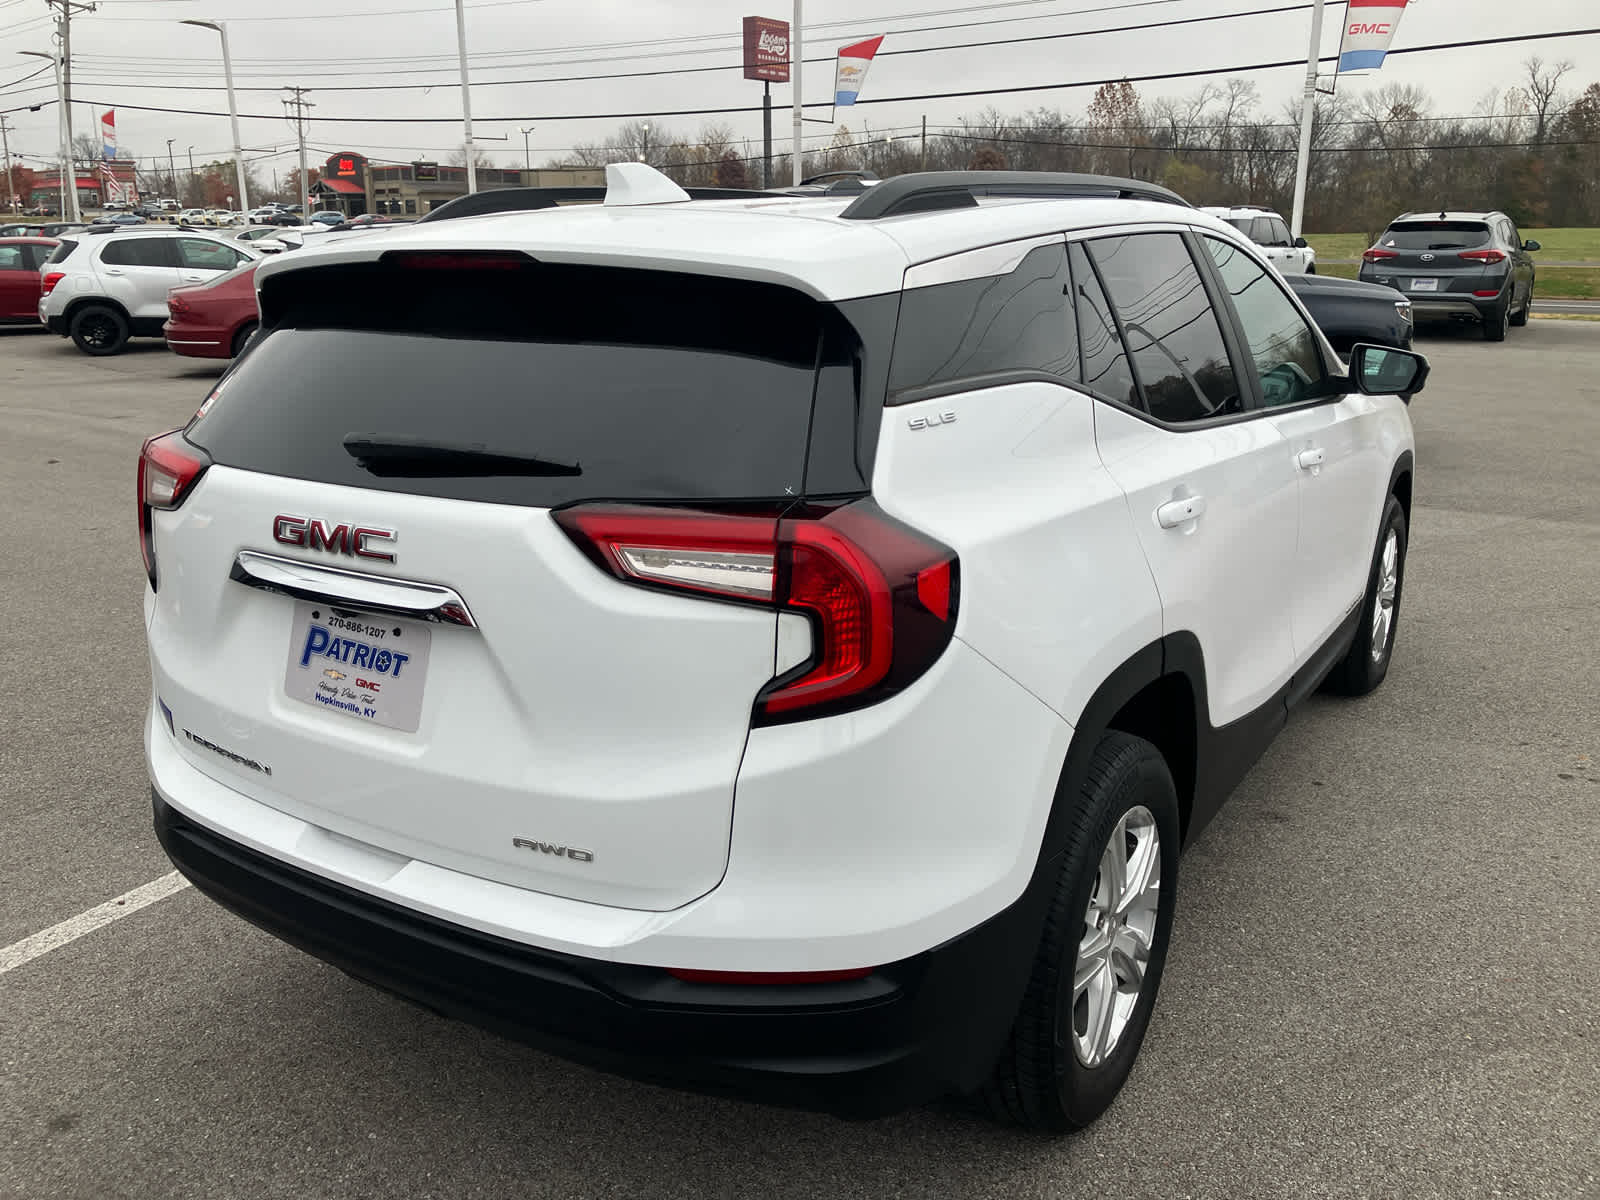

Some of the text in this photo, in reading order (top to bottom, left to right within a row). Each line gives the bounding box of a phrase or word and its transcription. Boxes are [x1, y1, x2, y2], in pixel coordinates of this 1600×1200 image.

[1347, 23, 1391, 35] GMC
[907, 410, 957, 431] SLE
[273, 514, 398, 564] GMC
[328, 616, 386, 639] 270-886-1207
[355, 677, 381, 692] GMC
[315, 691, 362, 716] Hopkinsville,
[363, 707, 377, 719] KY
[512, 836, 594, 862] AWD
